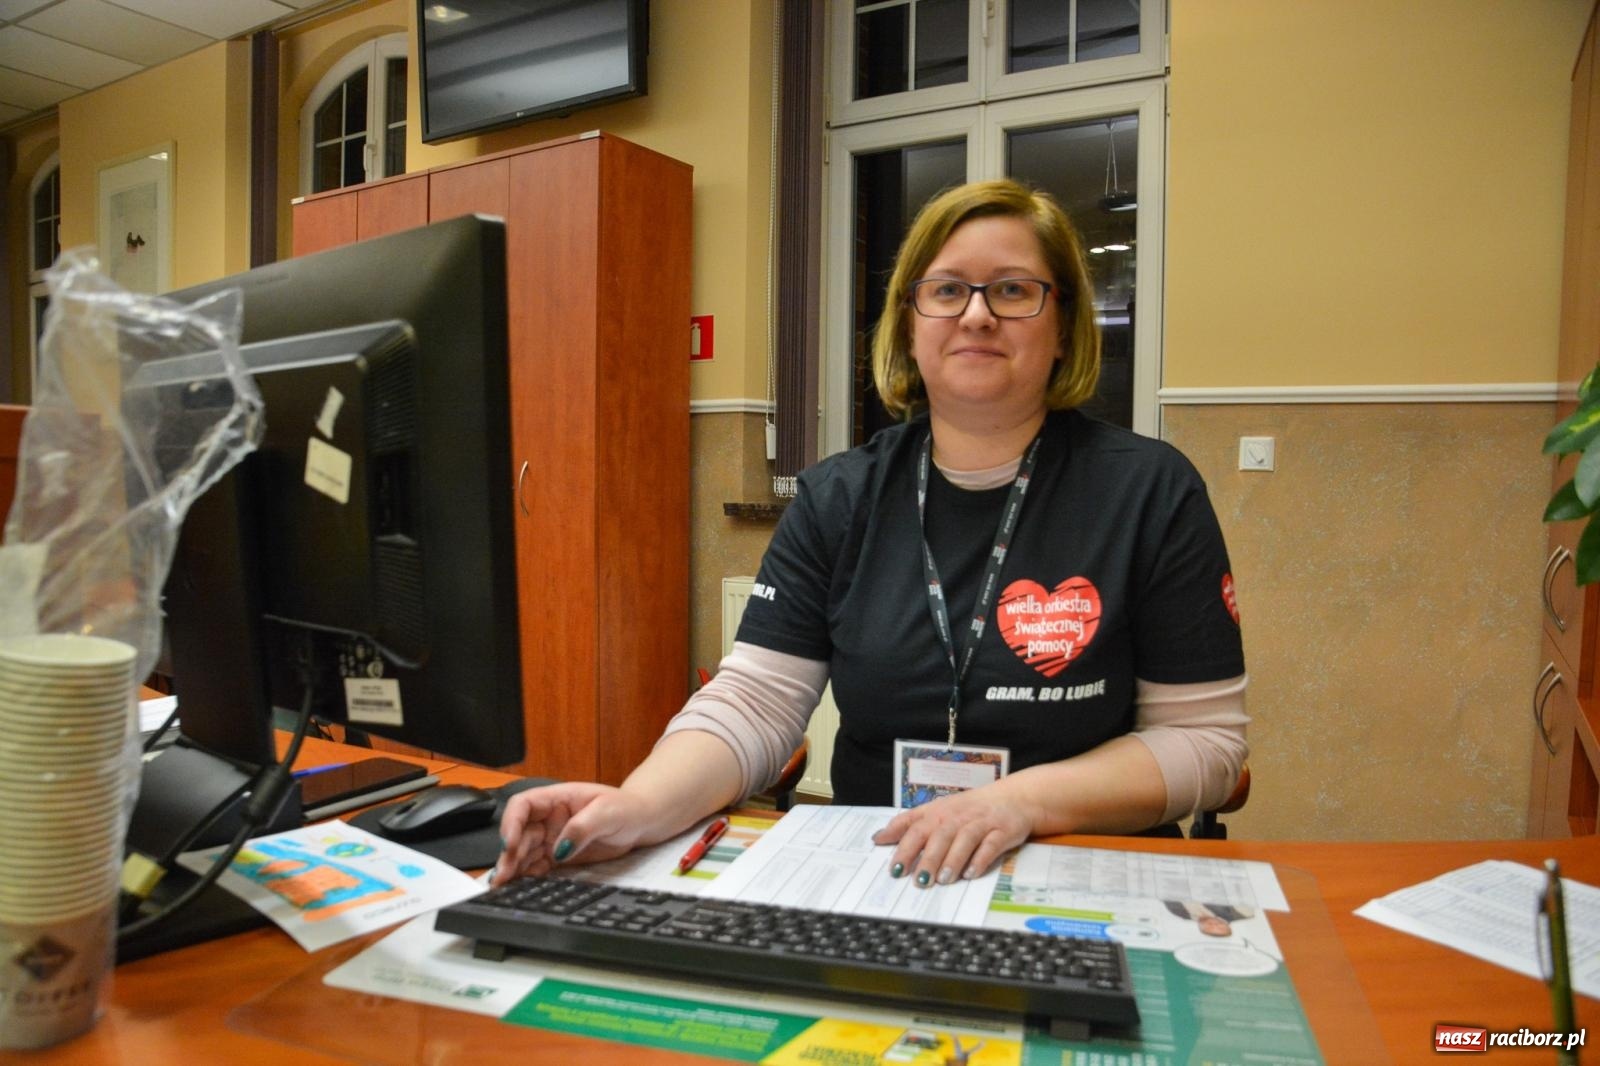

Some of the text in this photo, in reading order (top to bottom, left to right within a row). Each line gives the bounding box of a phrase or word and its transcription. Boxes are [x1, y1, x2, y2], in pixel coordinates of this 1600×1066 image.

[1045, 592, 1091, 613] orkiestra
[1014, 615, 1084, 641] świątecznej
[1027, 638, 1074, 659] pomocy
[1038, 687, 1063, 701] BO
